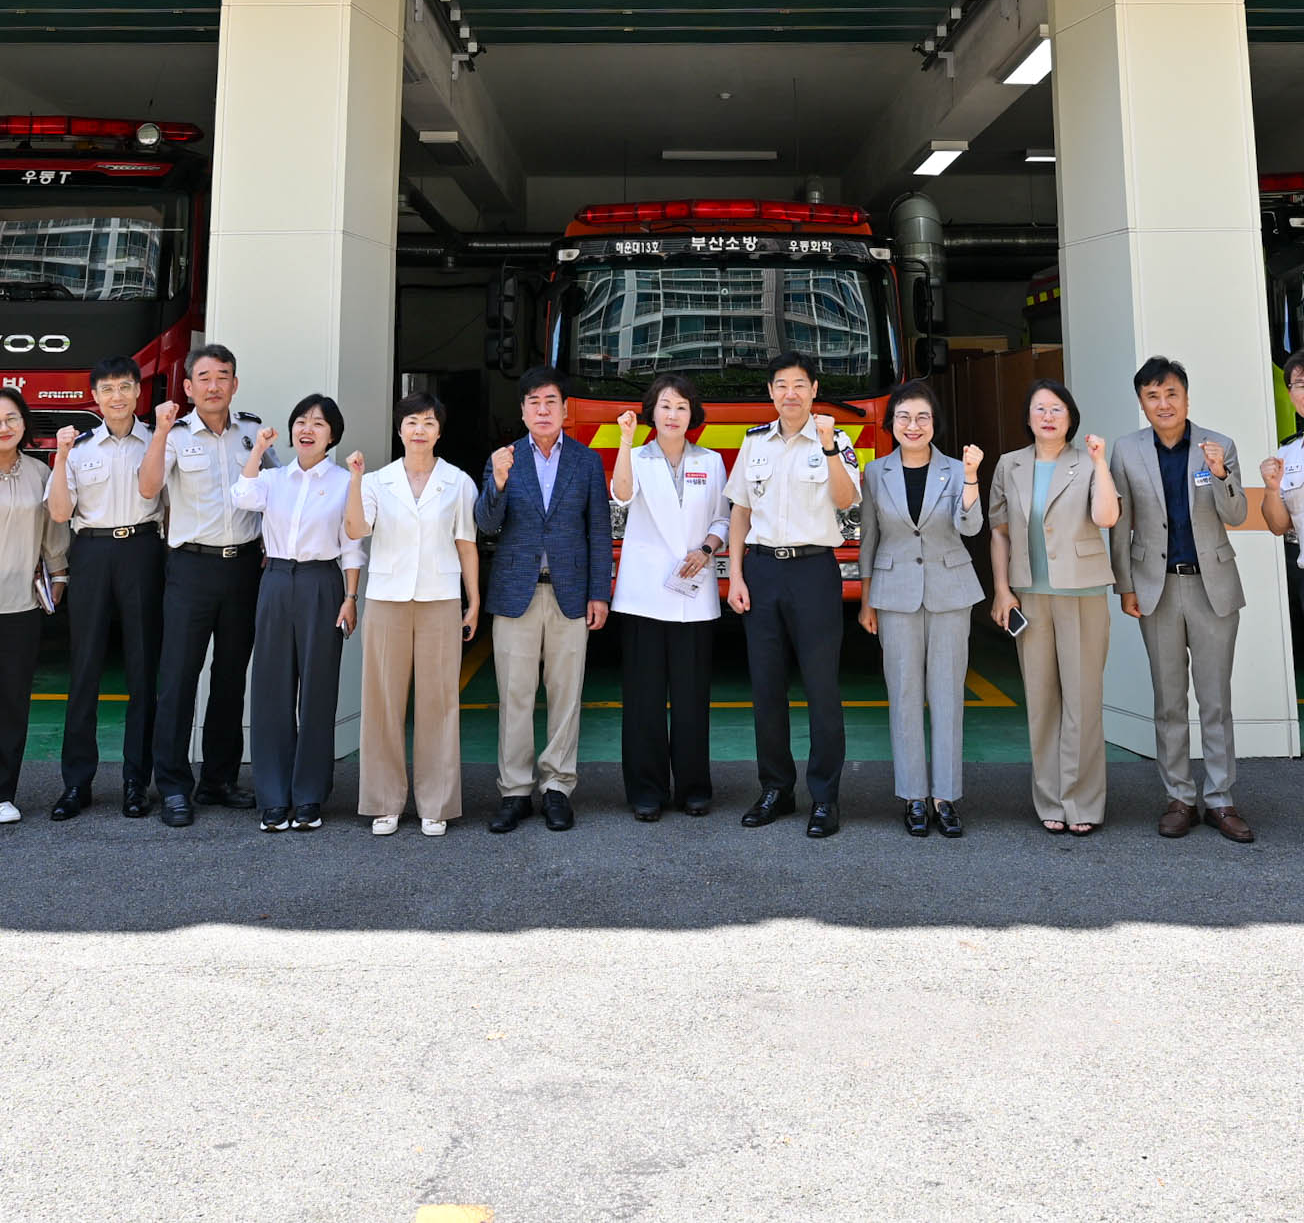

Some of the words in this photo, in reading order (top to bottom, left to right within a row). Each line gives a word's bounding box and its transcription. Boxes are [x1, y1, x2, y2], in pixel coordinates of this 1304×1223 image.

[21, 170, 56, 185] 우동
[59, 171, 72, 184] T
[615, 240, 661, 254] 해운대13호
[691, 236, 759, 252] 부산소방
[788, 240, 833, 253] 우동화학
[38, 390, 84, 399] PRIMA
